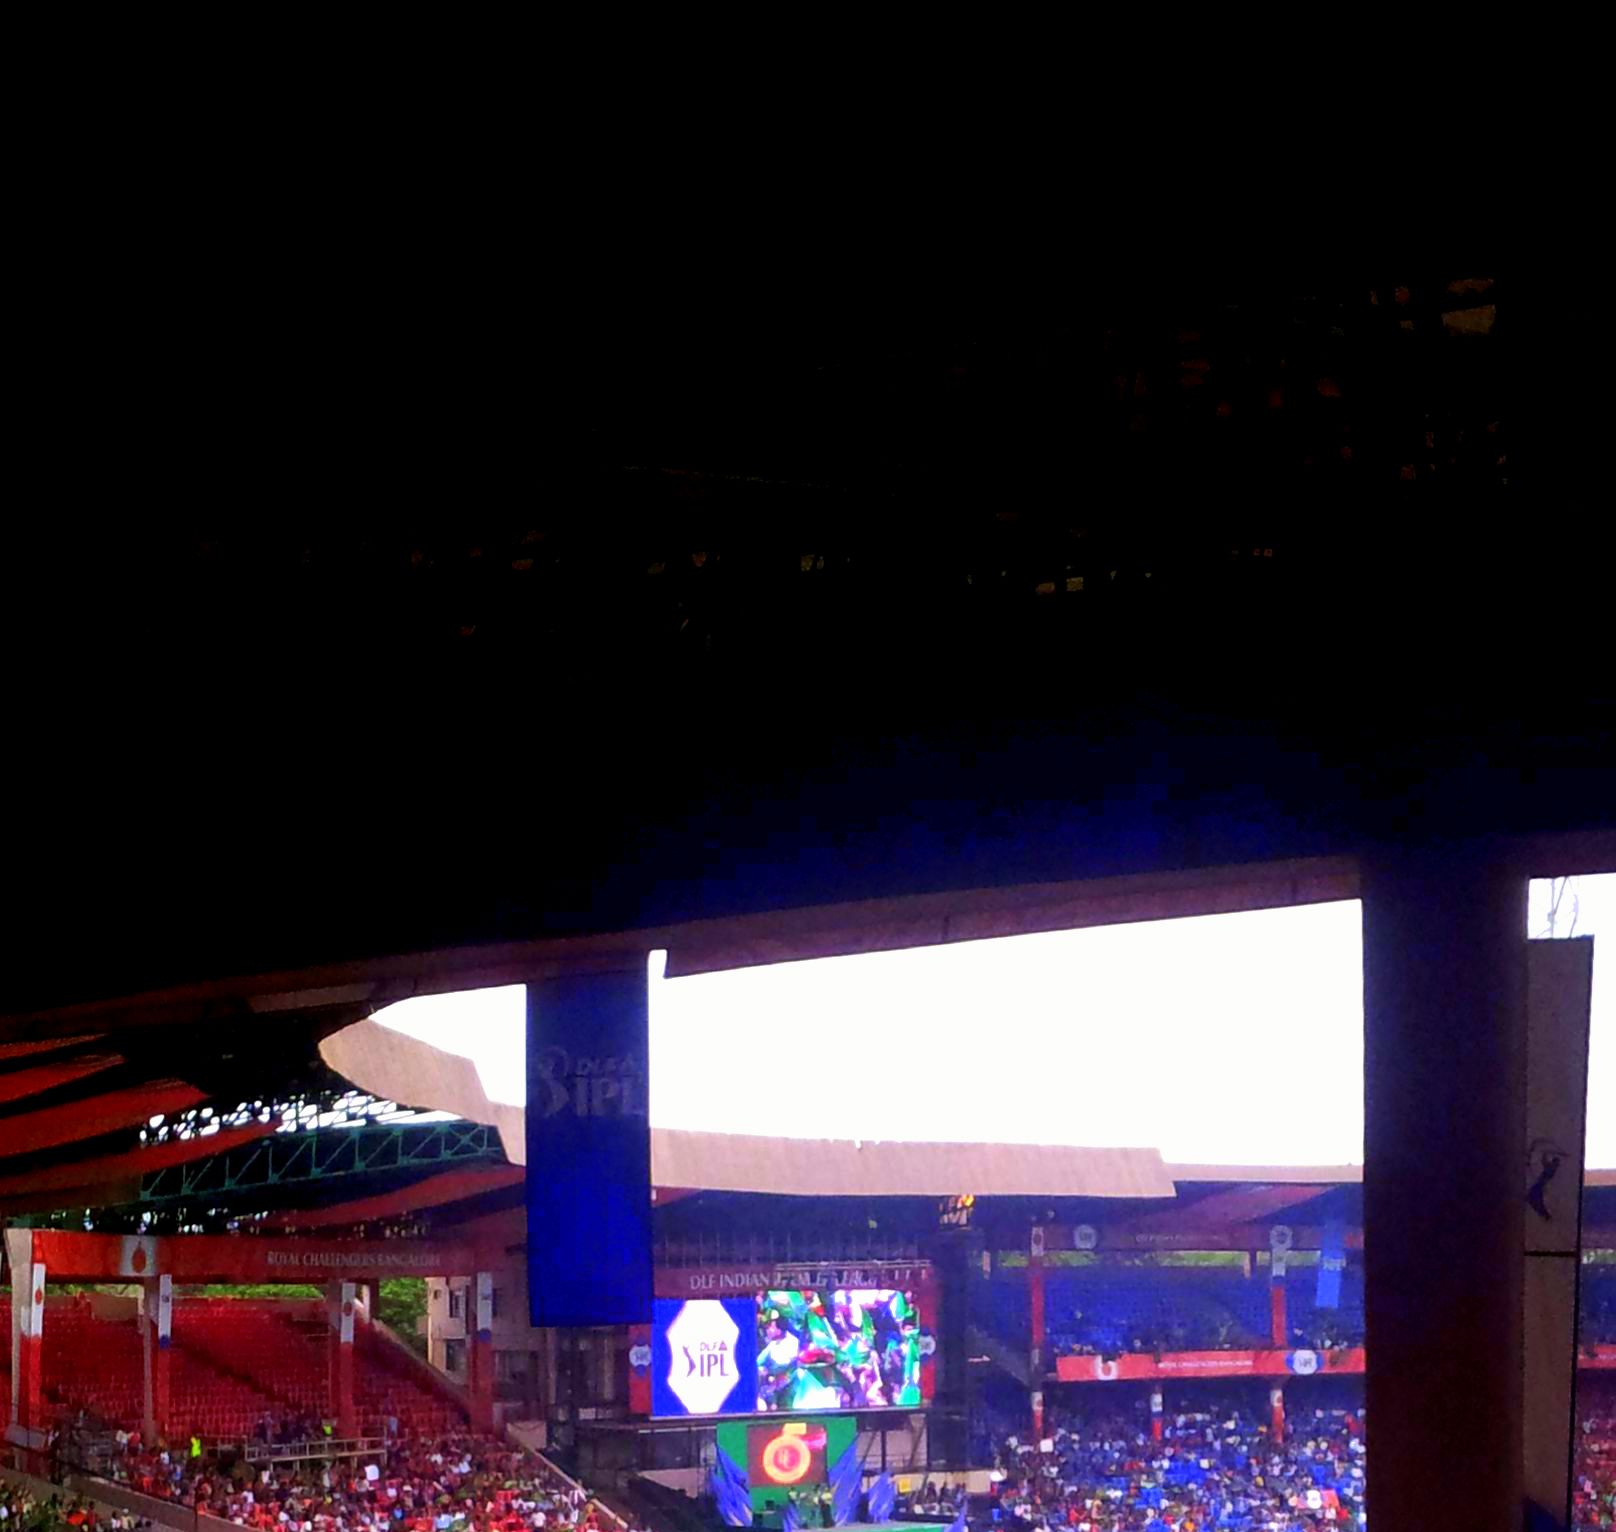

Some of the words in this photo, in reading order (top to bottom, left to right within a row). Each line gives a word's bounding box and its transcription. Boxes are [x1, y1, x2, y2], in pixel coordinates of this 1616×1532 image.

[267, 1251, 299, 1266] ROYAL
[690, 1275, 716, 1290] DLF
[719, 1273, 770, 1289] INDIAN
[700, 1354, 729, 1377] IPL
